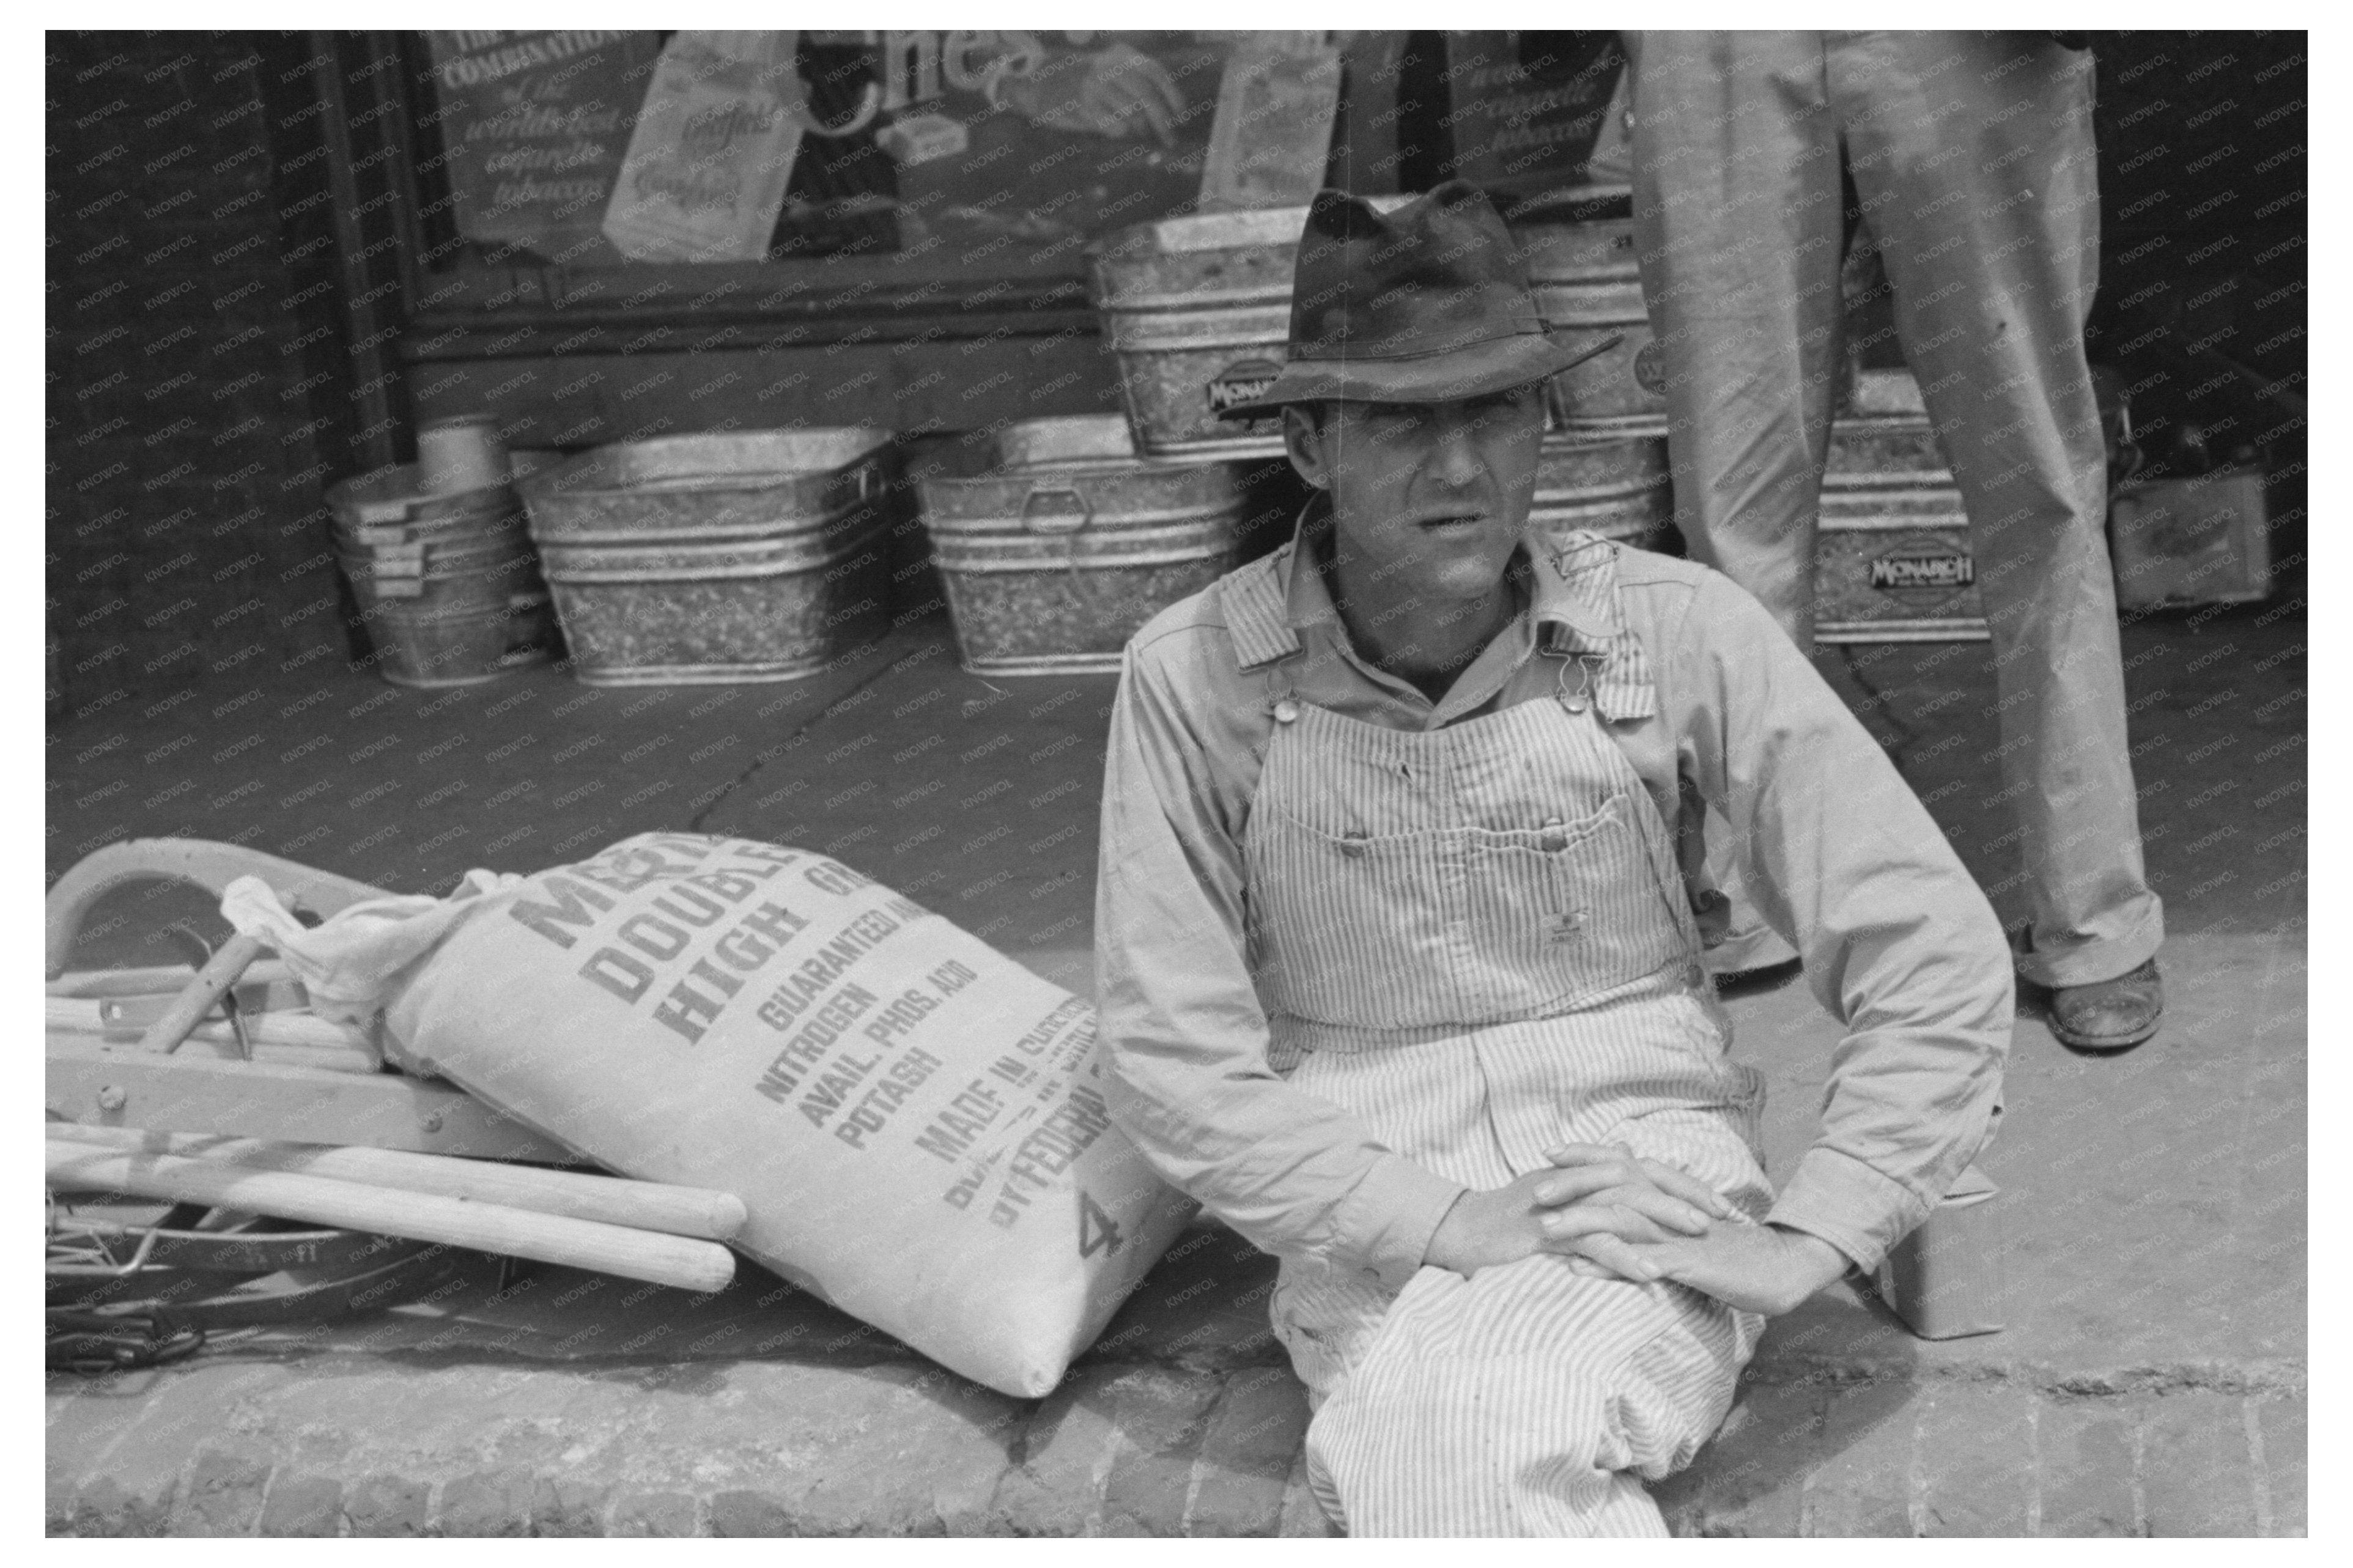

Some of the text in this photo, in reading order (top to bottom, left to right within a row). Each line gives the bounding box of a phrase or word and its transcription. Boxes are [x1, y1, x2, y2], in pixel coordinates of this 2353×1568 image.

[1871, 555, 1974, 586] MONARCH
[578, 845, 797, 1005] DOUBLE
[652, 900, 810, 1046] HIGH
[756, 909, 900, 1032] GUARANTEED
[755, 982, 879, 1104] NITROGEN
[798, 959, 978, 1129] AVAIL. PHOS. ACID
[833, 1046, 944, 1151] POTASH
[1077, 1189, 1125, 1260] 4
